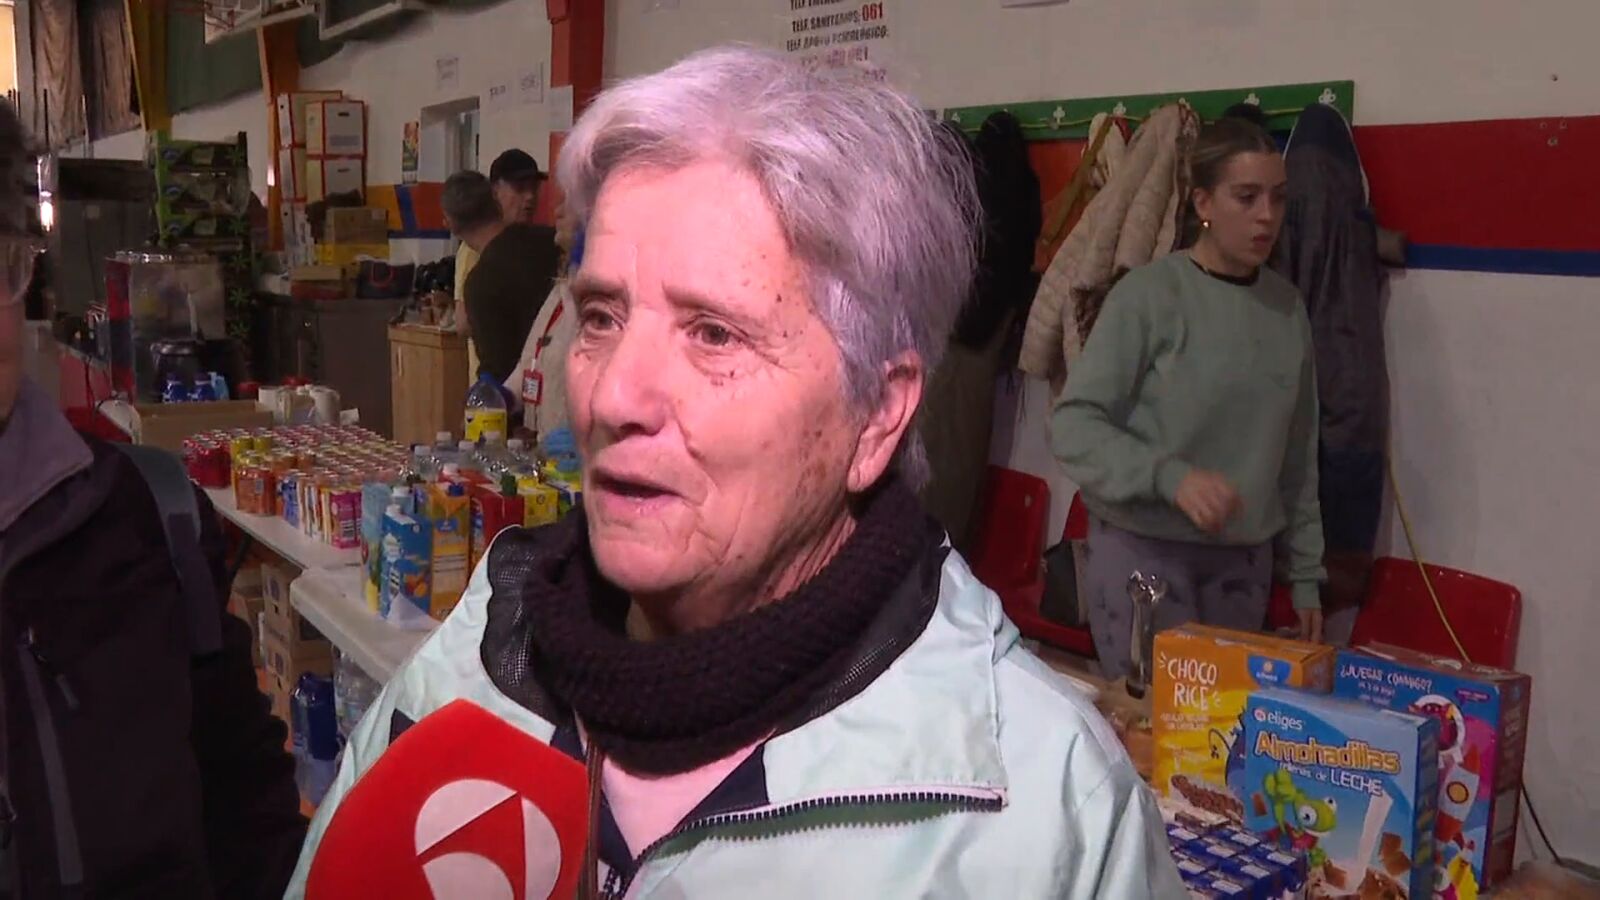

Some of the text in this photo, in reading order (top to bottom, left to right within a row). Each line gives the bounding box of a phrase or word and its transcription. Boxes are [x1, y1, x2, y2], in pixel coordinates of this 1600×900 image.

[862, 3, 883, 21] 061
[1167, 658, 1217, 686] CHOCO
[1174, 682, 1209, 711] RICE
[1267, 710, 1303, 730] eliges
[1253, 730, 1401, 775] Almohadillas
[1330, 767, 1383, 798] LECHE
